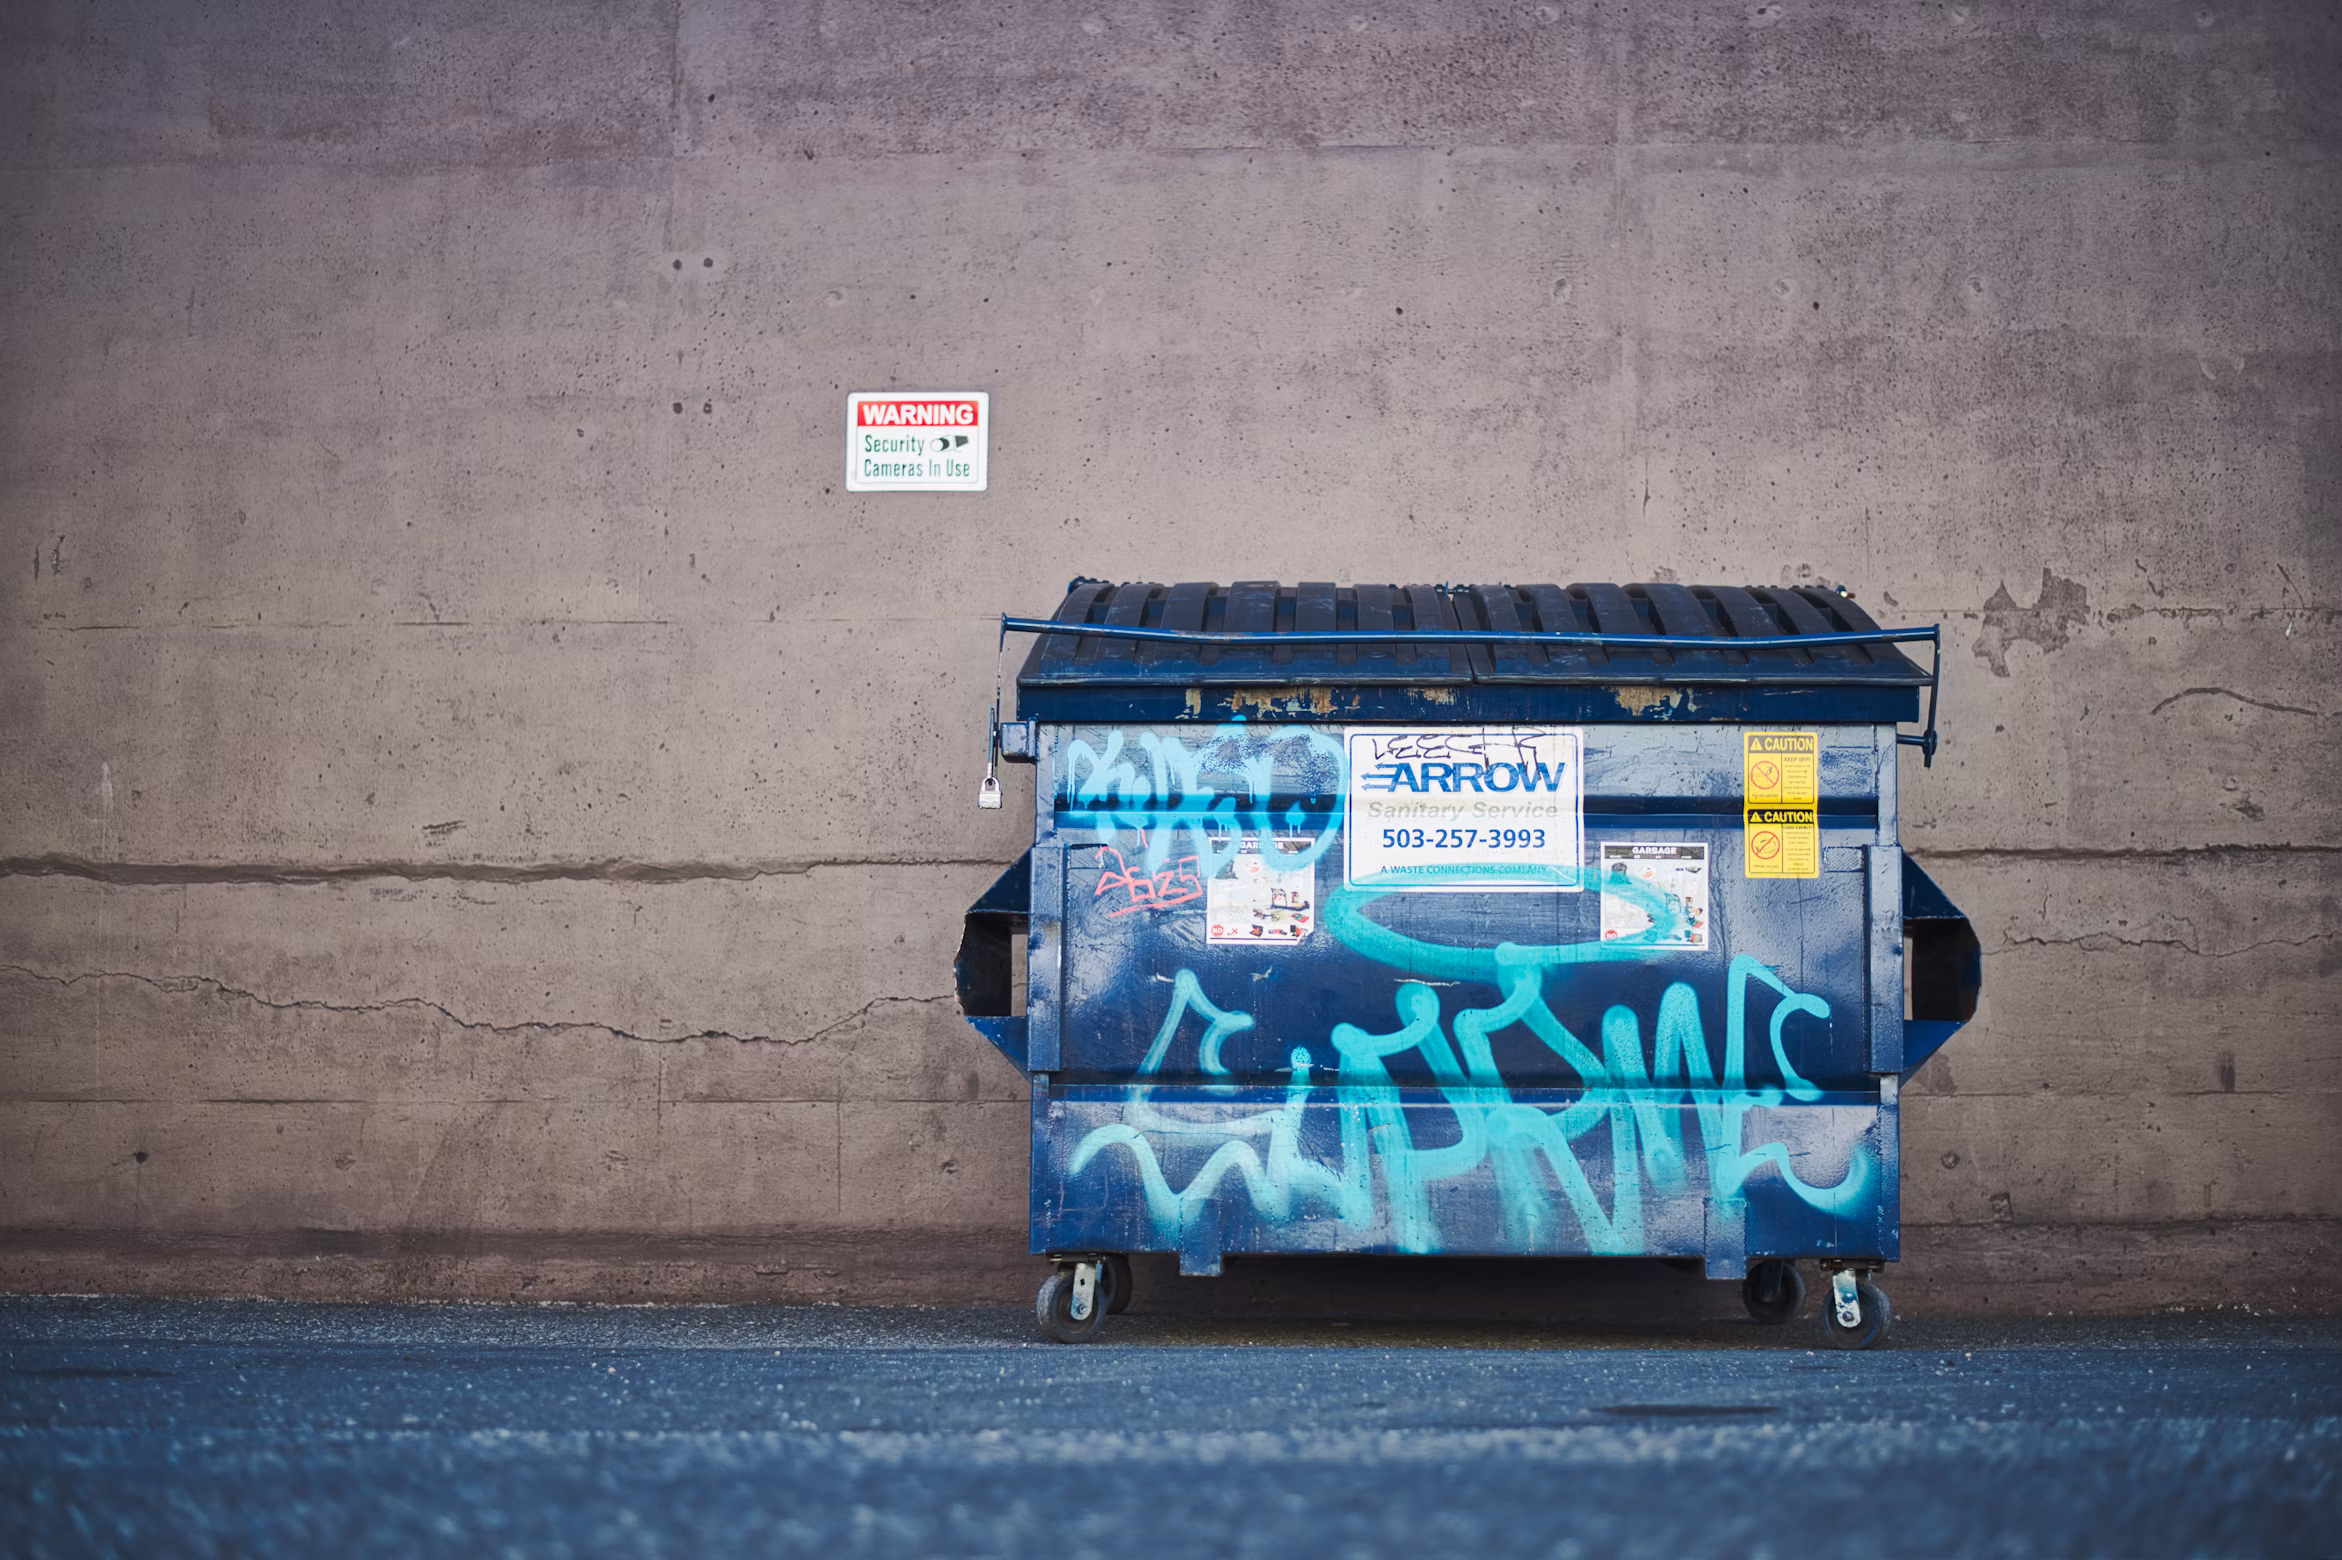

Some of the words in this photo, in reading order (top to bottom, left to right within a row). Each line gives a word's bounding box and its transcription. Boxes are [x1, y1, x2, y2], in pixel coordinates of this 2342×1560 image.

[862, 404, 974, 425] WARNING
[864, 434, 925, 456] Security
[864, 459, 923, 477] Cameras
[929, 459, 941, 477] In
[946, 459, 970, 477] Use
[1764, 737, 1813, 751] CAUTION
[1387, 762, 1566, 793] ARROW
[1368, 801, 1465, 822] Sanitary
[1471, 801, 1558, 819] Service
[1764, 811, 1813, 823] CAUTION
[1240, 841, 1284, 849] GARE
[1382, 829, 1546, 848] 503-257-3993
[1632, 846, 1677, 855] GARBAGE
[1381, 865, 1388, 874] A
[1390, 865, 1424, 874] WASTE
[1426, 865, 1495, 874] CONNECTIONS
[1498, 865, 1547, 874] COMPANY
